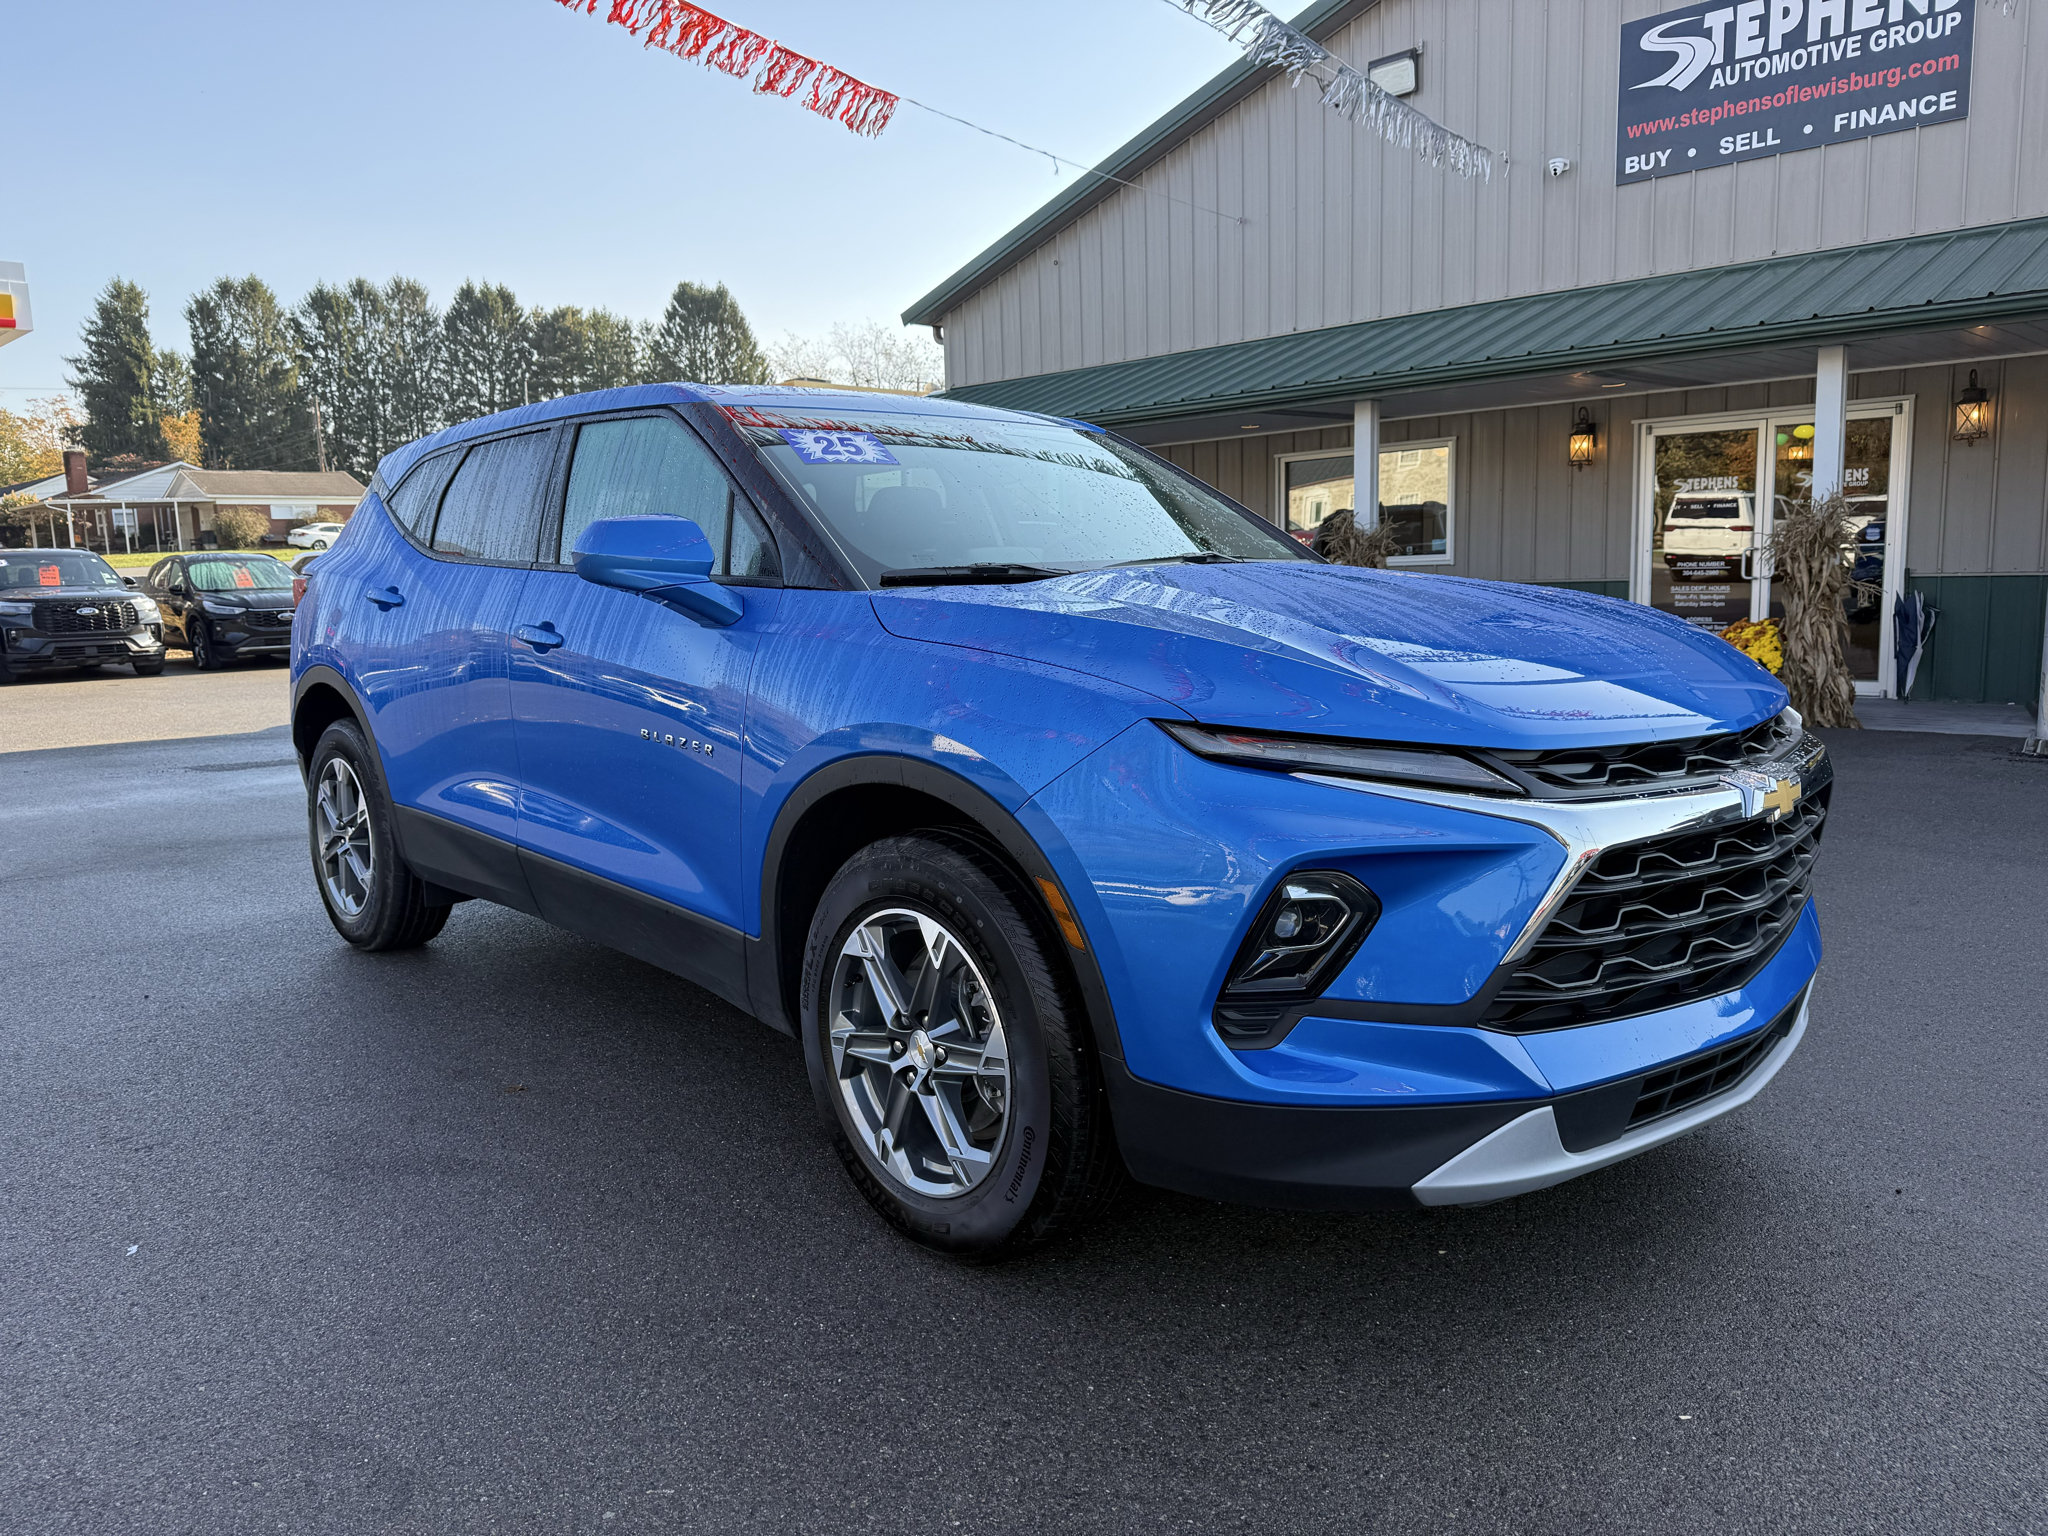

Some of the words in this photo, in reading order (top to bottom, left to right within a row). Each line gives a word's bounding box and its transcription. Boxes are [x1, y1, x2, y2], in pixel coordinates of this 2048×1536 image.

[1628, 0, 1959, 91] STEPHE
[1709, 35, 1861, 89] AUTOMOTIVE
[1869, 11, 1962, 52] GROUP
[1624, 149, 1672, 174] BUY
[1719, 128, 1781, 156] SELL
[1834, 90, 1957, 132] FINANCE
[1626, 53, 1960, 139] www.stephensoflewisburg.com
[813, 436, 866, 456] 25
[1672, 475, 1739, 493] STEPHENS
[640, 728, 714, 758] BLAZER
[1008, 1126, 1036, 1198] Continental
